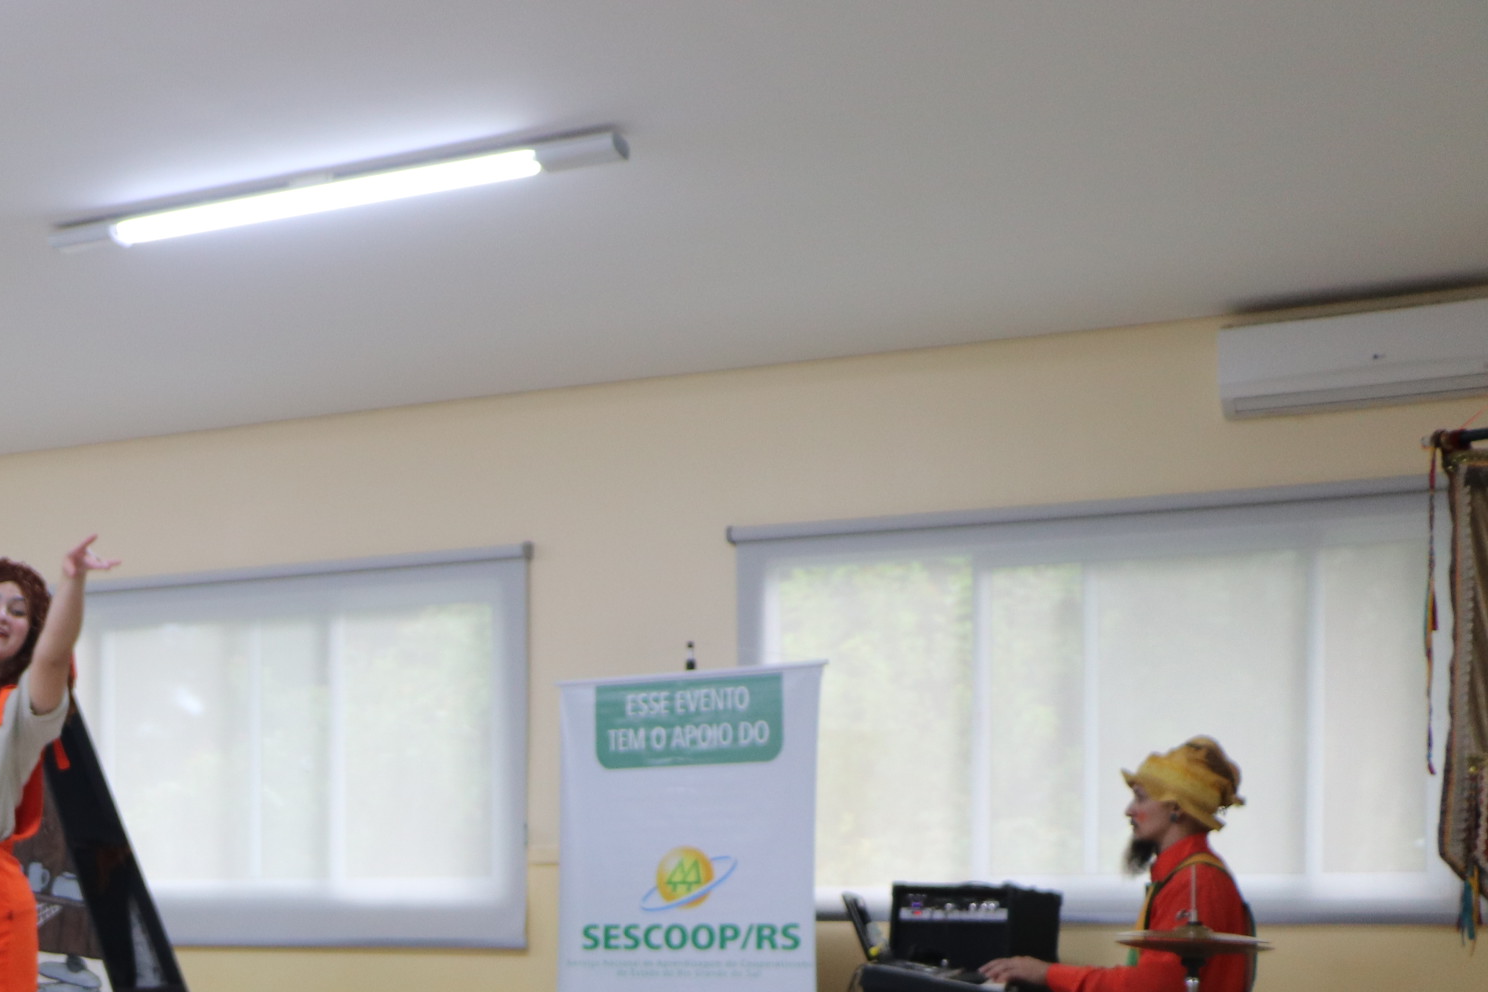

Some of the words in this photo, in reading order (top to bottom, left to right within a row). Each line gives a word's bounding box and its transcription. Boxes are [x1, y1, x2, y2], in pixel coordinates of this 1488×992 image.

[626, 691, 670, 717] ESSE
[674, 686, 750, 714] EVENTO
[608, 727, 645, 751] TEM
[650, 725, 666, 749] O
[670, 722, 733, 748] APOIO
[738, 720, 770, 746] DO
[581, 923, 802, 950] SESCOOP/RS
